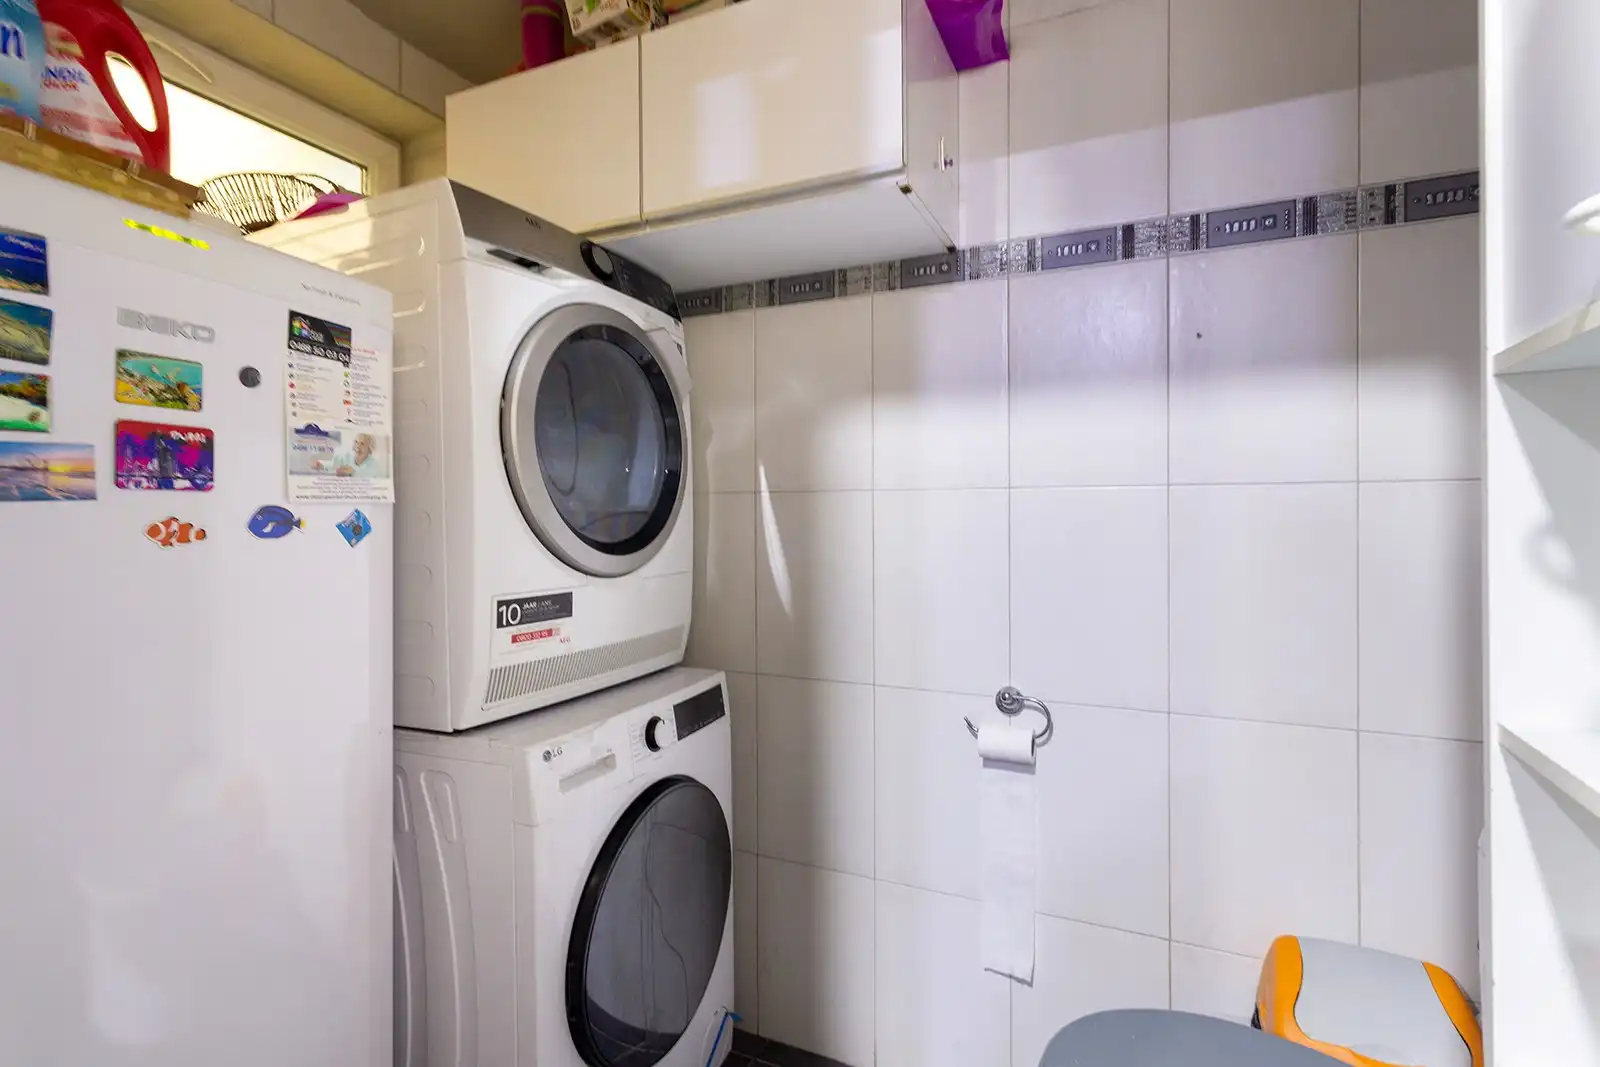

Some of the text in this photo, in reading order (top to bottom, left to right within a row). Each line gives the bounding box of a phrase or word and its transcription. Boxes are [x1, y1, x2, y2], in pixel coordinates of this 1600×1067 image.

[116, 306, 215, 343] BEKO
[498, 603, 521, 626] 10
[551, 746, 563, 758] LG
